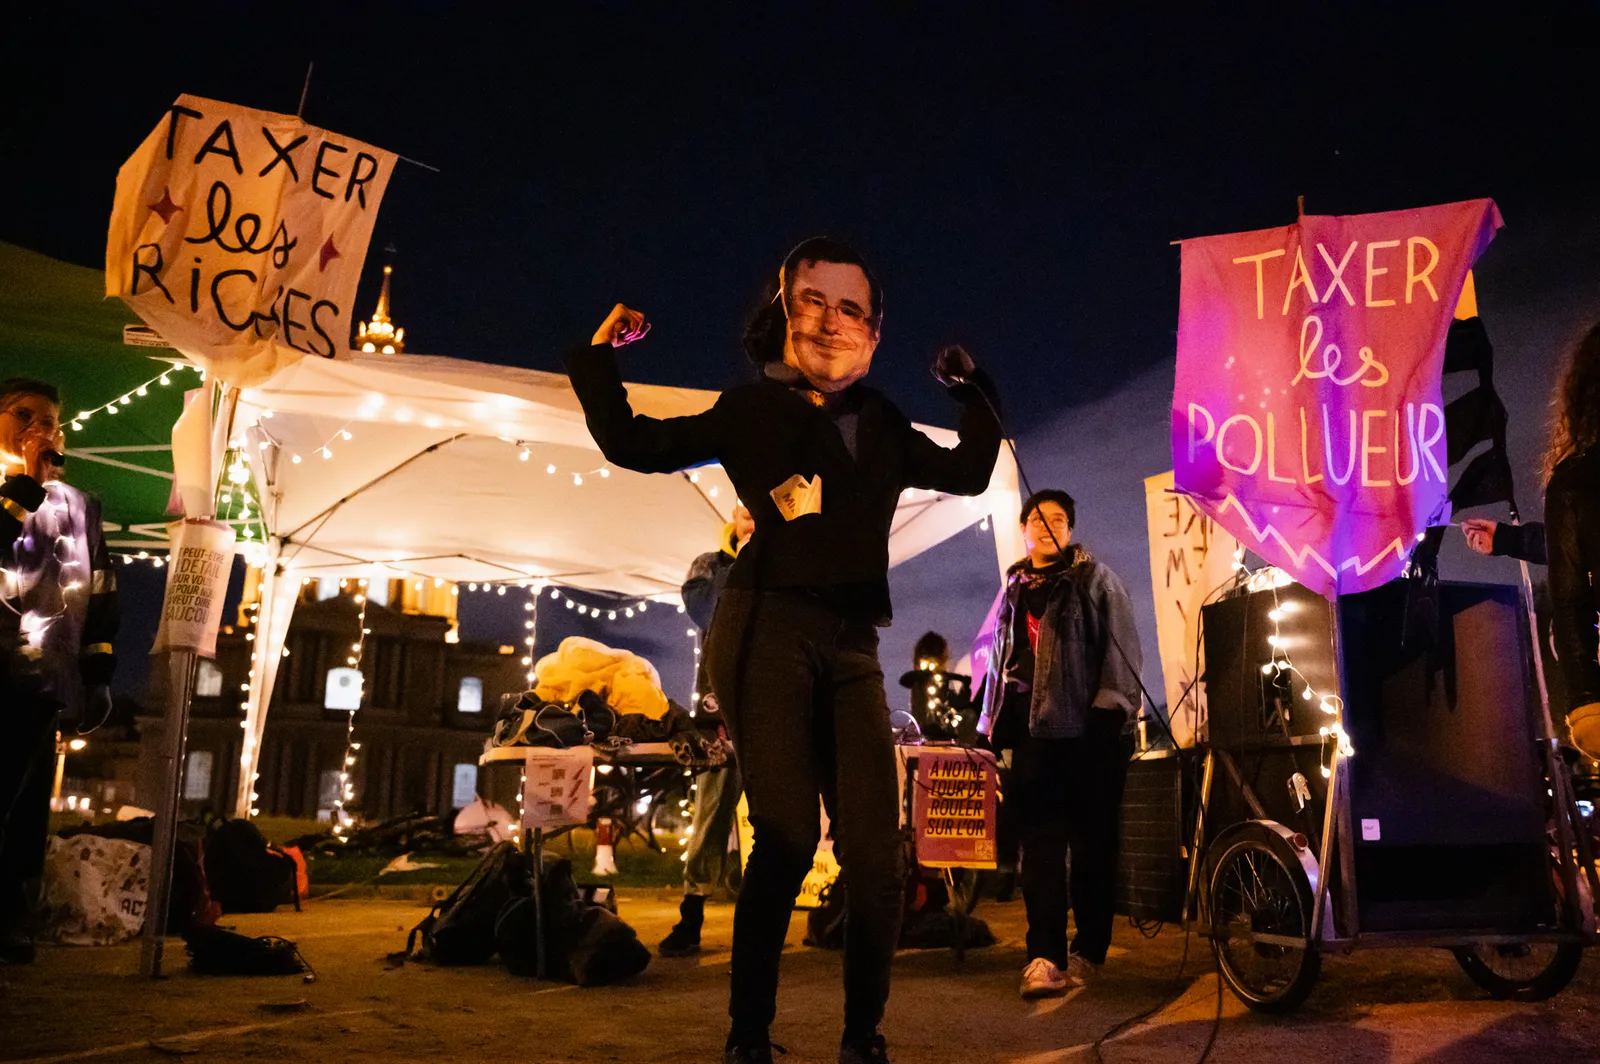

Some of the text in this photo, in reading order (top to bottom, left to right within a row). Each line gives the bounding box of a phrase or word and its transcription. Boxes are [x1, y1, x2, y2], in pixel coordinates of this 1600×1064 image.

[167, 105, 378, 211] TAXER
[184, 181, 298, 269] les
[1232, 236, 1440, 320] TAXER
[1291, 315, 1390, 387] les
[176, 584, 199, 595] POUR
[942, 761, 985, 778] NOTRE
[931, 780, 986, 797] TOUR DE
[930, 800, 983, 816] ROULER
[927, 818, 985, 835] SUR L'OR
